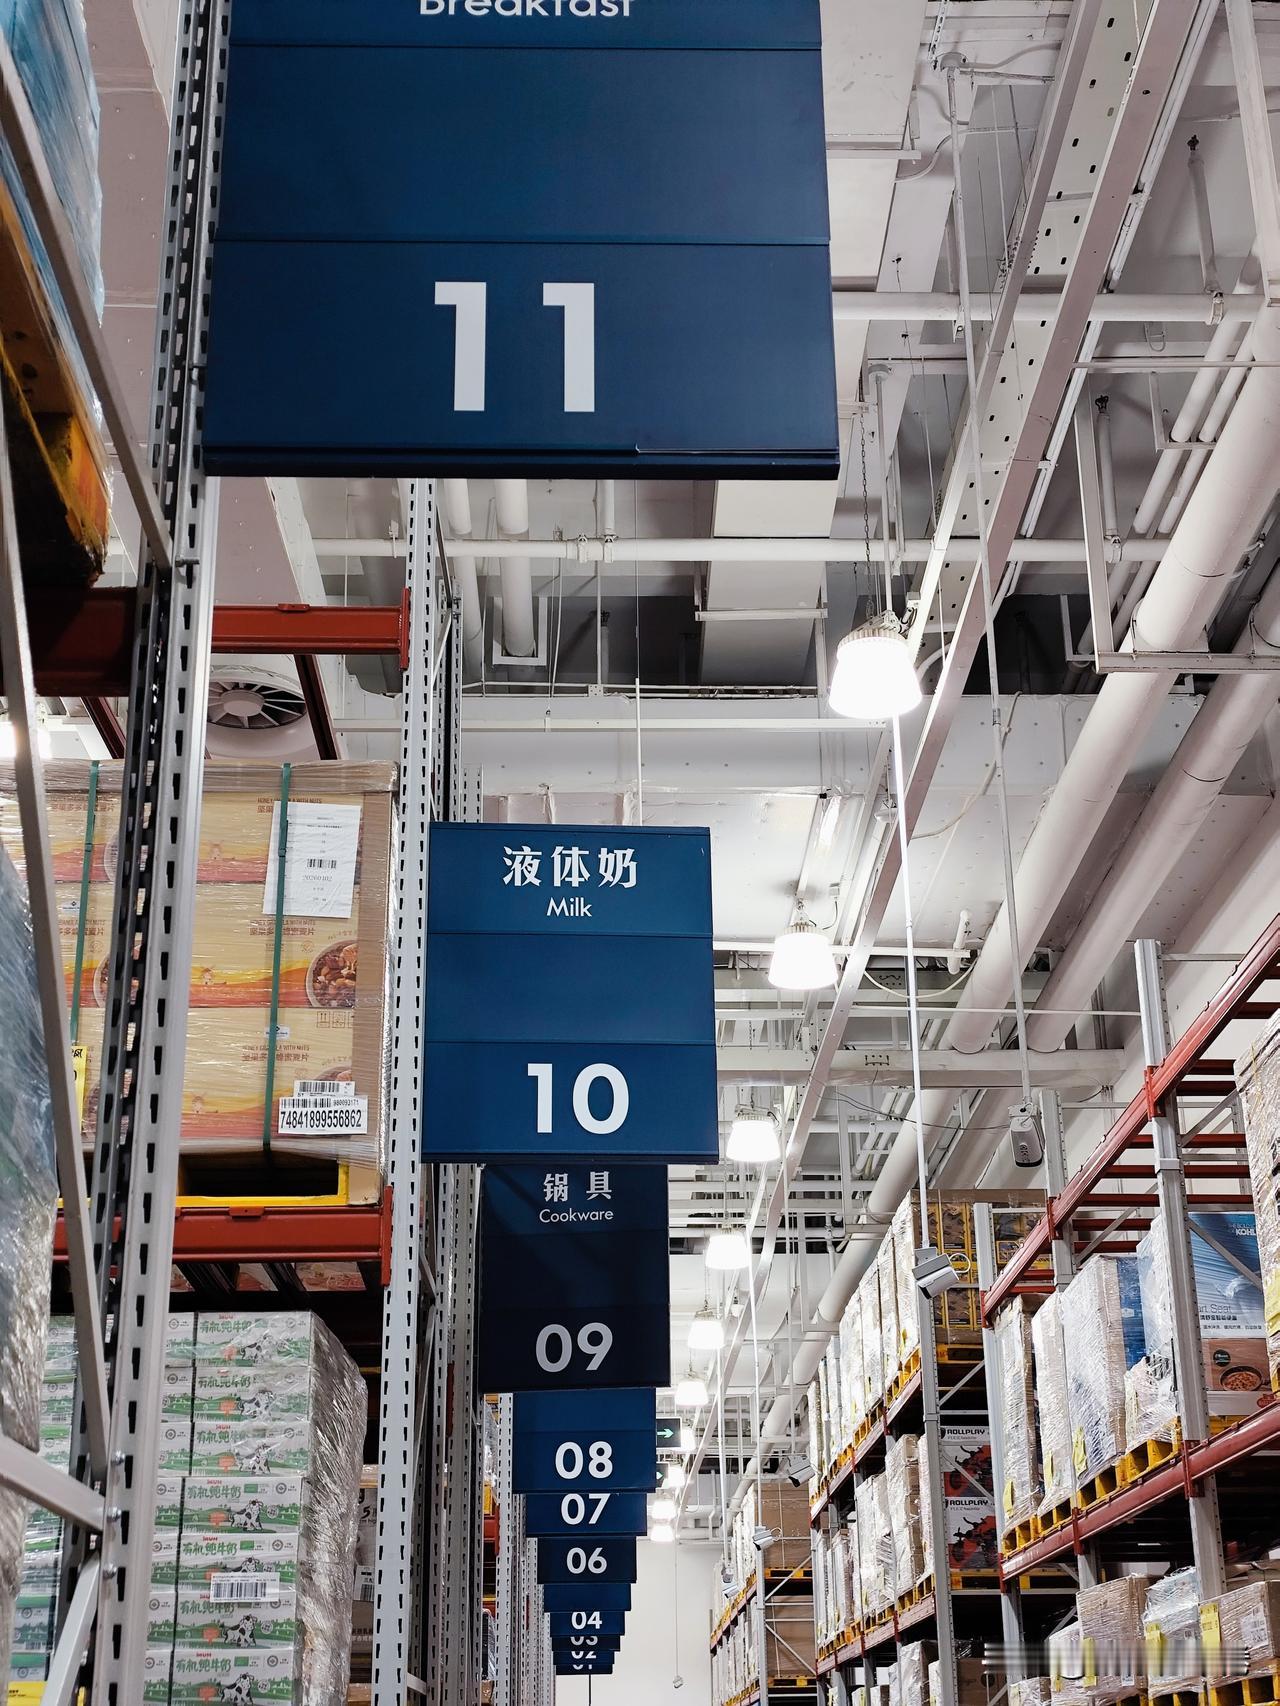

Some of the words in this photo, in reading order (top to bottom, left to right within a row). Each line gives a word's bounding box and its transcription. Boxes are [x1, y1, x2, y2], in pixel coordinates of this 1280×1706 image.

[434, 281, 595, 412] 11
[502, 846, 638, 889] 液体奶
[546, 897, 592, 917] Milk
[527, 1063, 630, 1135] 10
[280, 1109, 362, 1128] 74841899556862
[543, 1171, 612, 1203] 锅具
[540, 1208, 614, 1223] Cookware
[535, 1322, 613, 1373] 09
[555, 1440, 614, 1480] 08
[560, 1493, 611, 1525] 07
[182, 1541, 237, 1556] 有机纯牛奶
[566, 1547, 608, 1575] 06
[571, 1611, 603, 1630] 04
[175, 1658, 231, 1673] 有机纯牛奶
